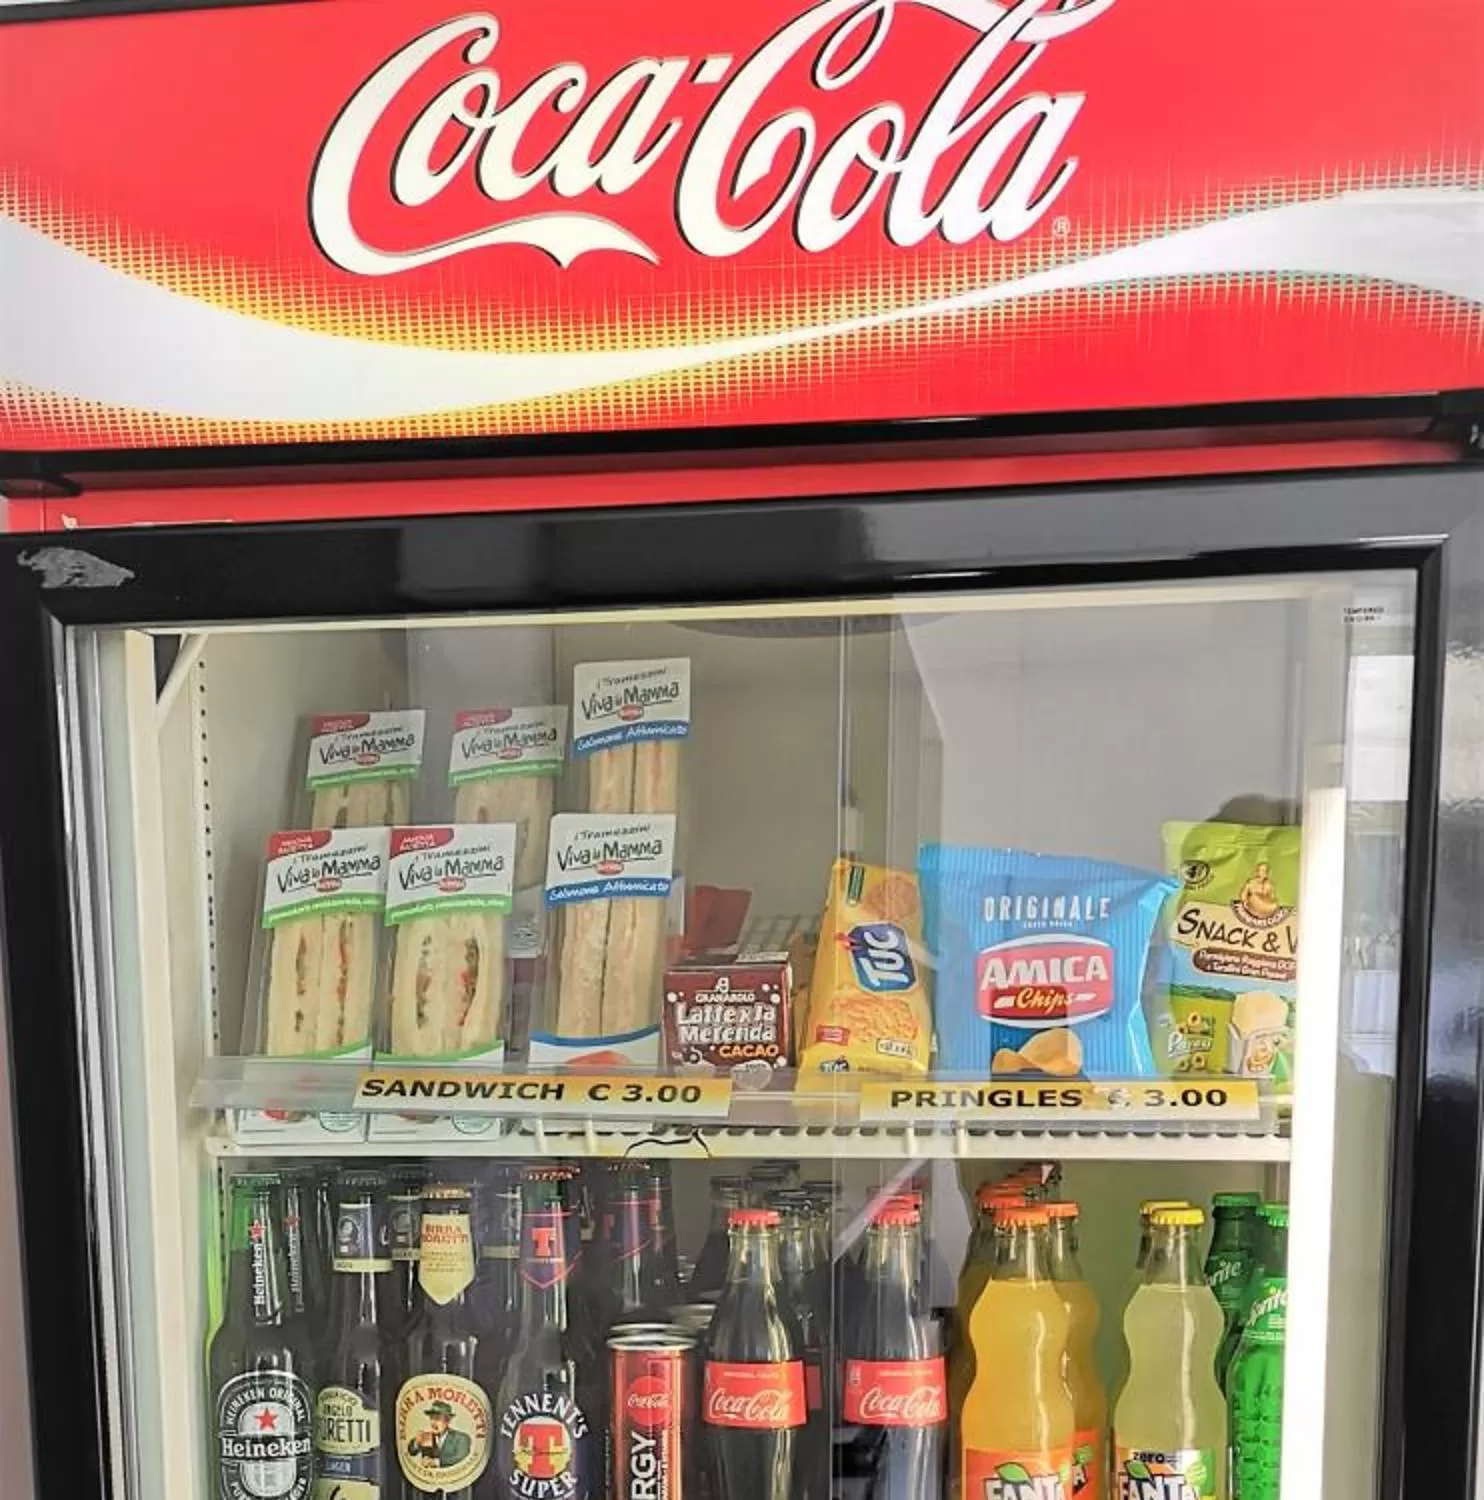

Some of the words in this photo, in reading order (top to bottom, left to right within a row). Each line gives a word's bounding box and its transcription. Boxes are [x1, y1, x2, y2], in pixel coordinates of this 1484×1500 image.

[305, 0, 1117, 277] Coca-Cola
[582, 692, 612, 720] Viva
[624, 681, 679, 703] Mamma
[320, 741, 349, 764] Viva
[361, 733, 416, 753] Mamma
[462, 737, 492, 759] Viva
[504, 728, 557, 748] Mamma
[557, 844, 591, 871] Viva
[603, 839, 662, 861] Mamma
[277, 865, 310, 893] Viva
[321, 855, 381, 877] Mamma
[399, 863, 432, 891] Viva
[445, 855, 504, 877] Mamma
[984, 895, 1112, 923] ORIGINALE
[1177, 908, 1259, 949] SNACK
[1262, 931, 1281, 954] &
[859, 930, 911, 988] TUC
[980, 955, 1109, 992] AMICA
[1015, 987, 1075, 1015] Chips
[678, 1022, 777, 1043] Merenda
[720, 1044, 779, 1058] CACAO
[361, 1078, 565, 1101] SANDWICH
[621, 1084, 701, 1103] 3.00
[890, 1089, 1083, 1108] PRINGLES
[1143, 1088, 1229, 1108] 3.00
[251, 1242, 266, 1306] Heineken
[1205, 1260, 1242, 1287] rite
[225, 1387, 265, 1426] HEINEKEN
[427, 1386, 485, 1440] MORETTI
[500, 1393, 590, 1439] TENNENT'S
[627, 1392, 672, 1410] Coca-Cola
[709, 1387, 793, 1423] Coca-Cola
[859, 1385, 942, 1422] Coca-Cola
[321, 1417, 371, 1443] ORETTI
[222, 1437, 311, 1459] Heineken
[1133, 1450, 1165, 1465] zero
[509, 1469, 578, 1499] SUPER
